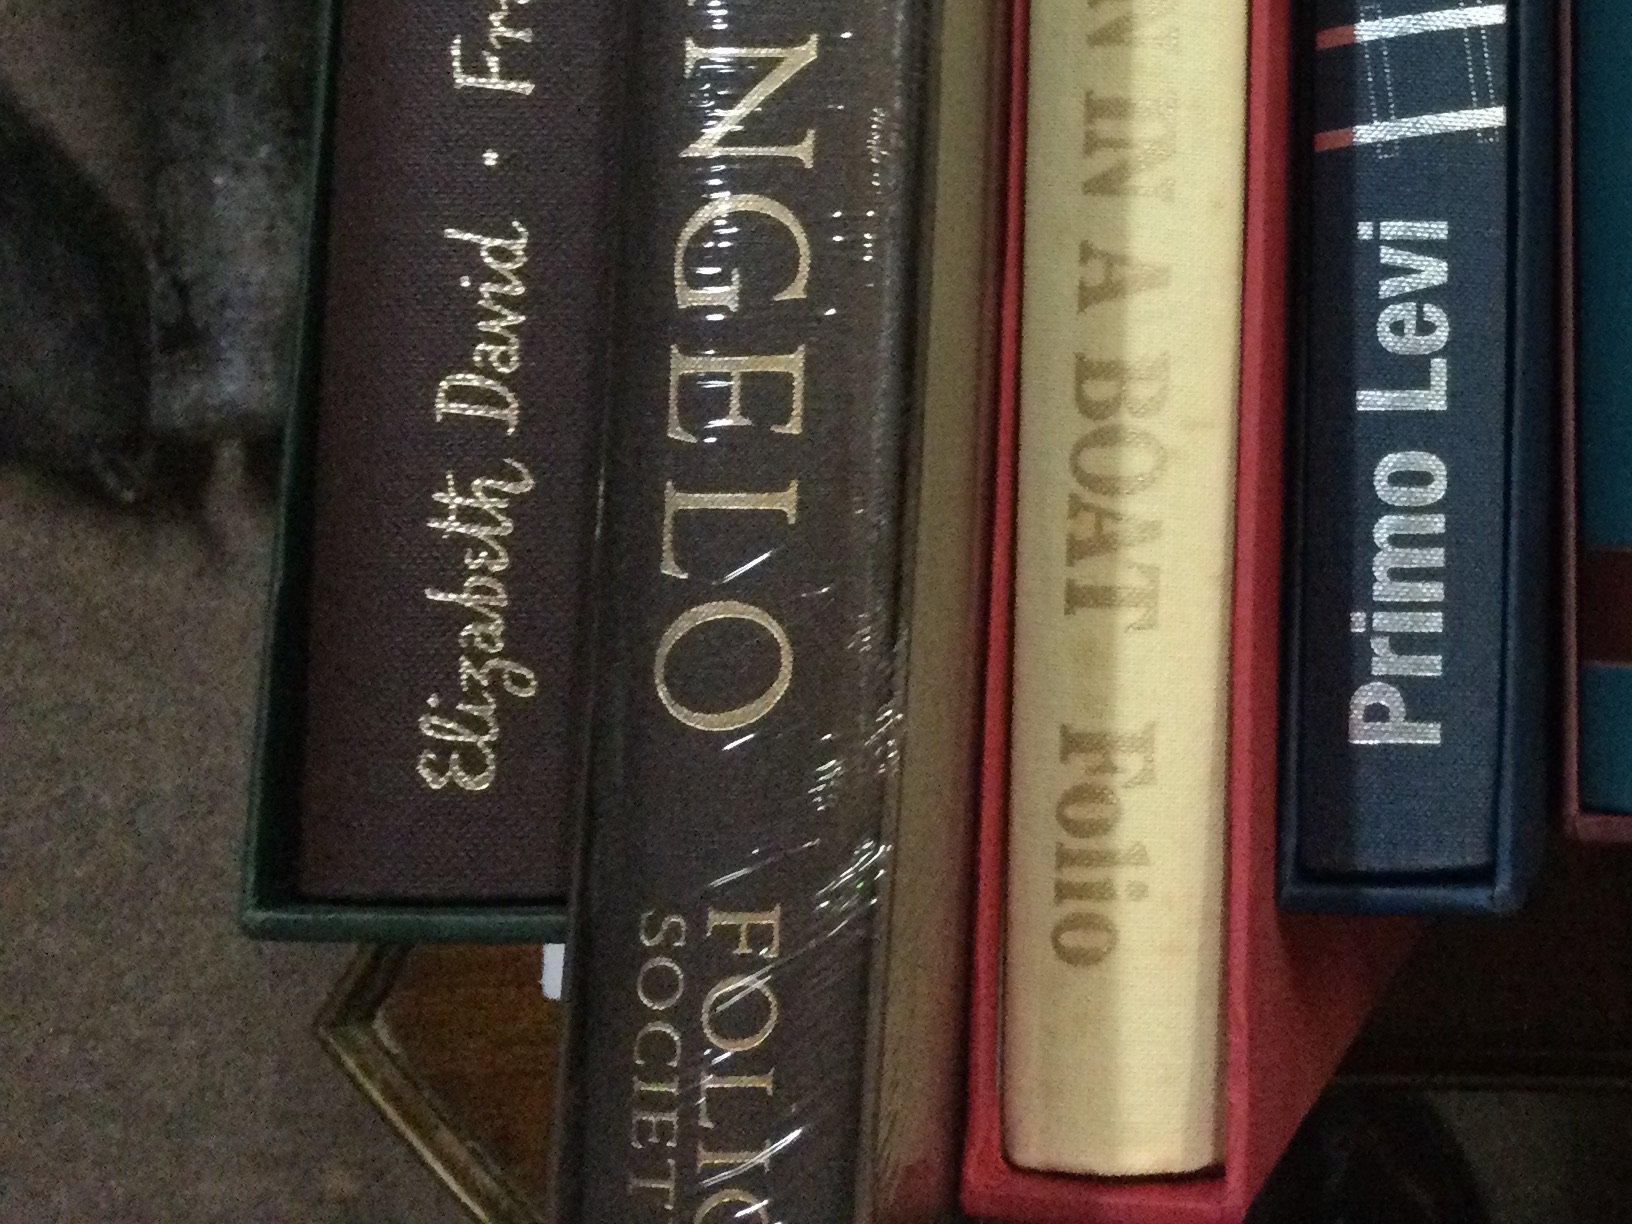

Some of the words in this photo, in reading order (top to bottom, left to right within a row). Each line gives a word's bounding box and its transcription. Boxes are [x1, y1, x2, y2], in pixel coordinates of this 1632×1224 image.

[1081, 90, 1179, 201] IN
[434, 219, 529, 438] David
[1076, 239, 1171, 314] A
[1355, 220, 1451, 411] Levi
[1063, 352, 1170, 632] BOAT
[1348, 450, 1448, 746] Primo
[416, 457, 538, 792] Elizabeth
[1050, 722, 1157, 967] Folio
